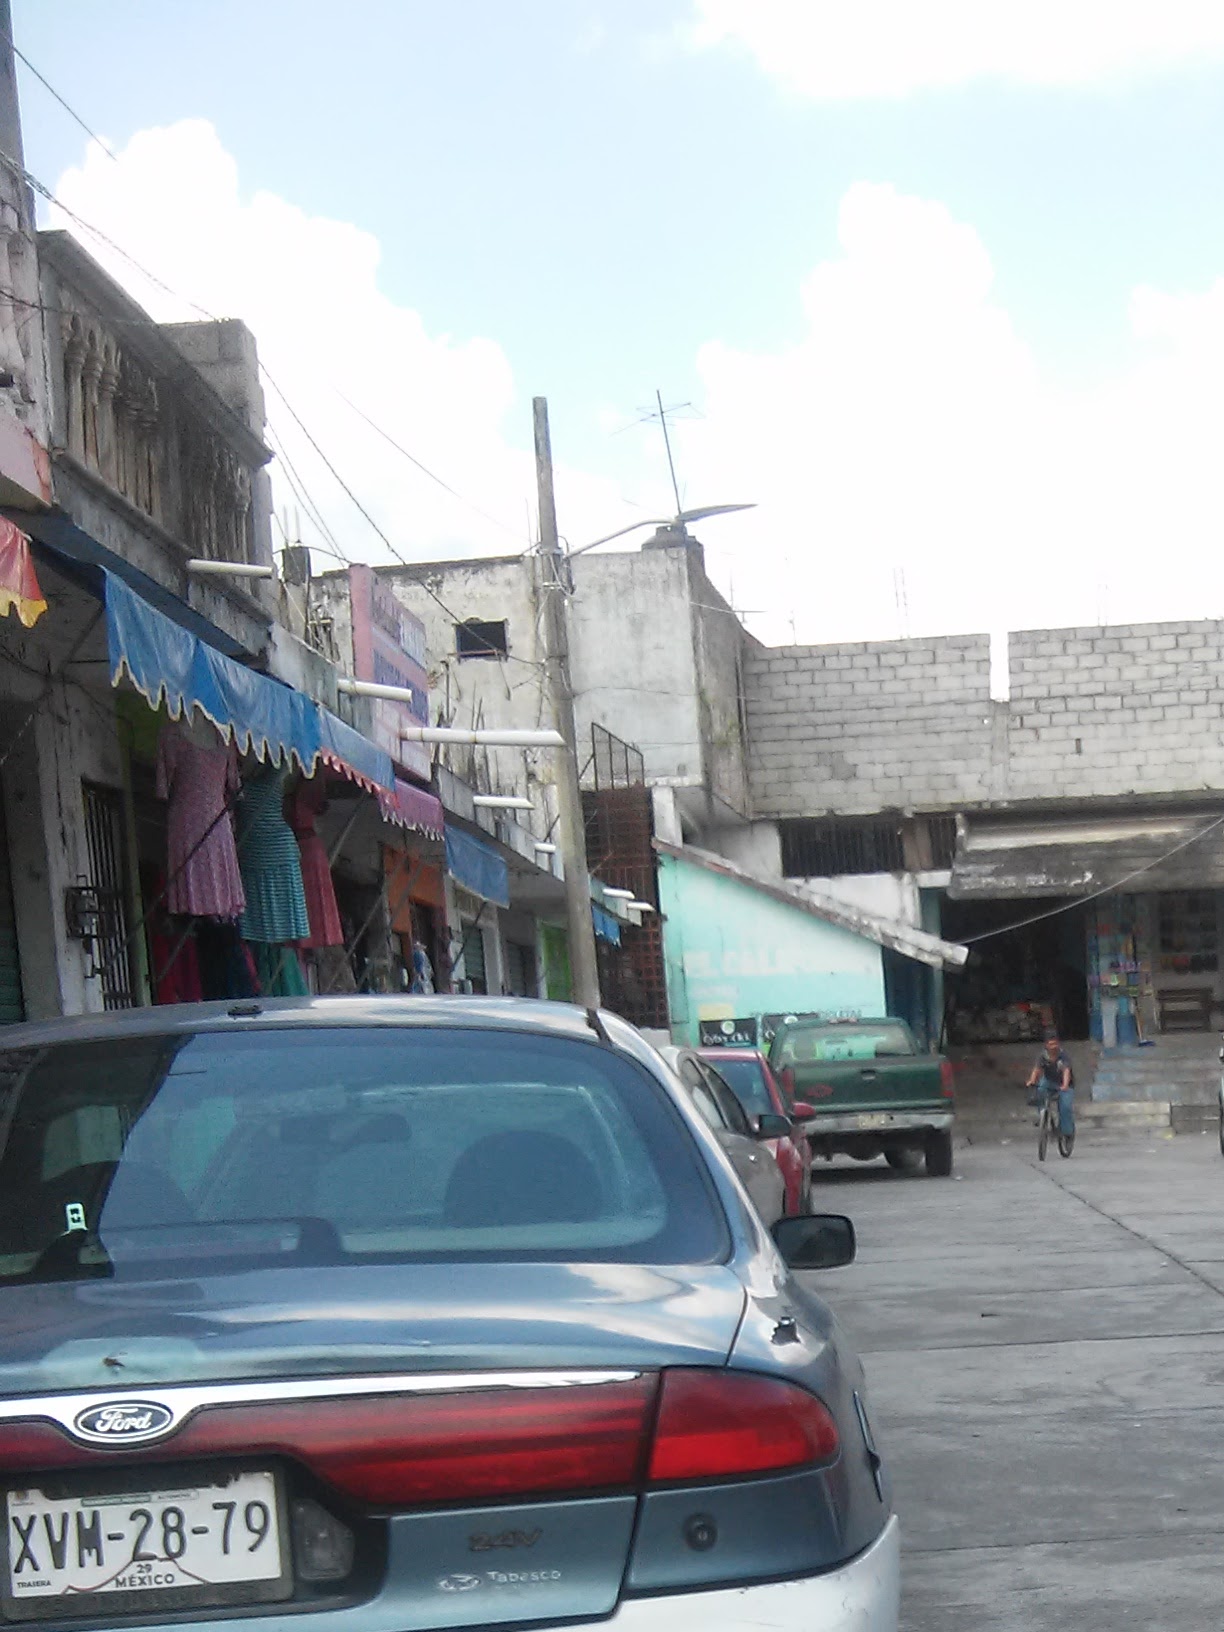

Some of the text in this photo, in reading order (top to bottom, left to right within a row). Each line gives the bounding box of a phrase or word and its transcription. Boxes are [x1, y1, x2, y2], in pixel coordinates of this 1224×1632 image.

[95, 1408, 152, 1432] Ford
[12, 1500, 271, 1573] XVM-28-79
[17, 1580, 52, 1588] TRASERA
[115, 1573, 176, 1589] MÉXICO
